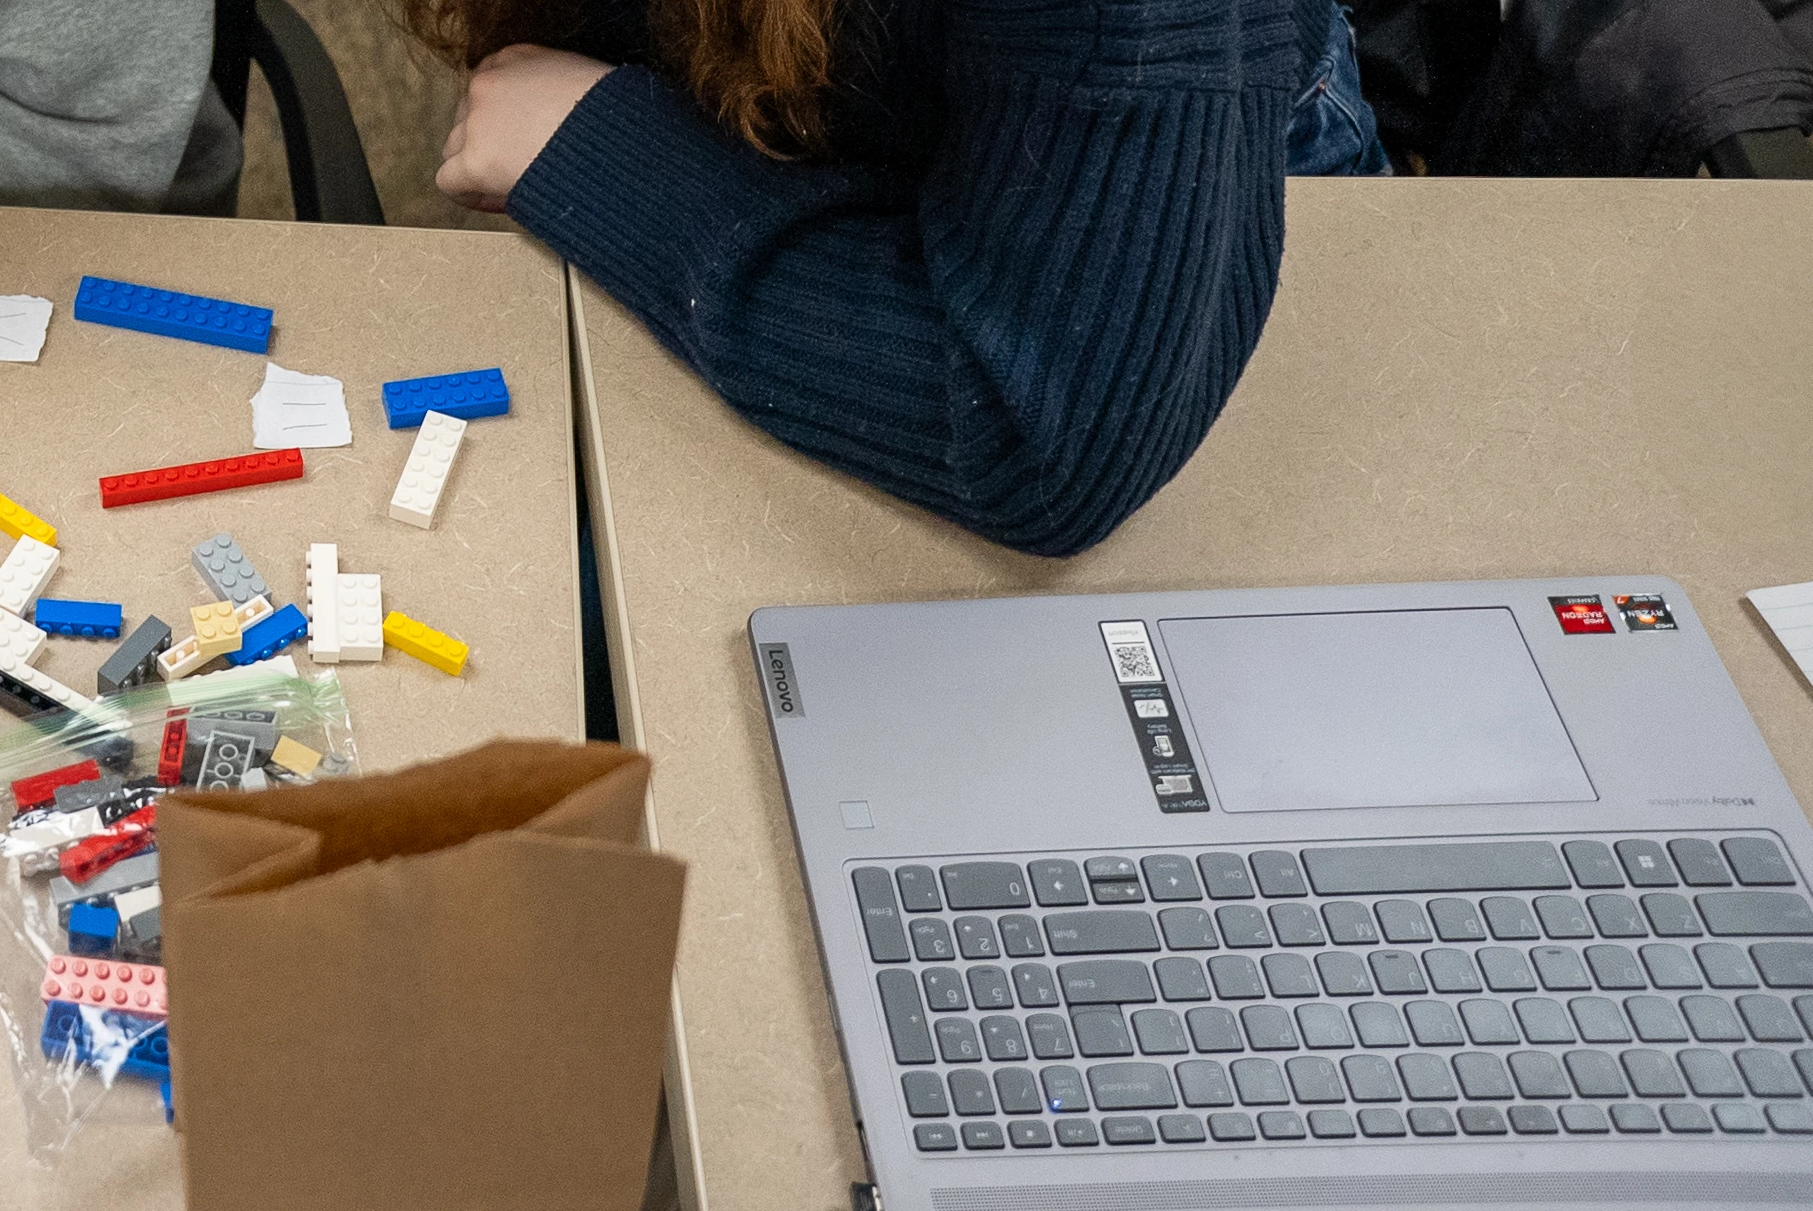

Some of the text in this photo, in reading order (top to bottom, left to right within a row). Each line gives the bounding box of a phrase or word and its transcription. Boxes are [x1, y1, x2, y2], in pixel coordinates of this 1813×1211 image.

[1561, 611, 1604, 619] RADEON
[1627, 609, 1665, 619] RYZEN
[769, 650, 794, 713] Lenovo
[1010, 882, 1020, 895] 0
[866, 907, 892, 916] Enter
[1411, 921, 1424, 934] N
[1464, 920, 1476, 932] B
[1520, 918, 1532, 931] V
[1571, 917, 1586, 930] C
[1625, 916, 1638, 930] X
[1680, 914, 1693, 929] Z
[1053, 930, 1077, 939] Shift
[1355, 923, 1372, 935] M
[933, 939, 944, 952] 3
[978, 937, 989, 950] 2
[1026, 937, 1032, 949] 1
[1068, 979, 1095, 989] Enter
[1300, 975, 1312, 988] L
[1352, 974, 1366, 987] K
[1408, 972, 1417, 985] J
[1458, 972, 1473, 984] H
[947, 990, 958, 1002] 6
[992, 988, 1002, 1000] 5
[1038, 986, 1049, 999] 4
[1279, 1029, 1291, 1041] P
[961, 1040, 972, 1053] 9
[1006, 1039, 1017, 1052] 8
[1053, 1038, 1063, 1050] 7
